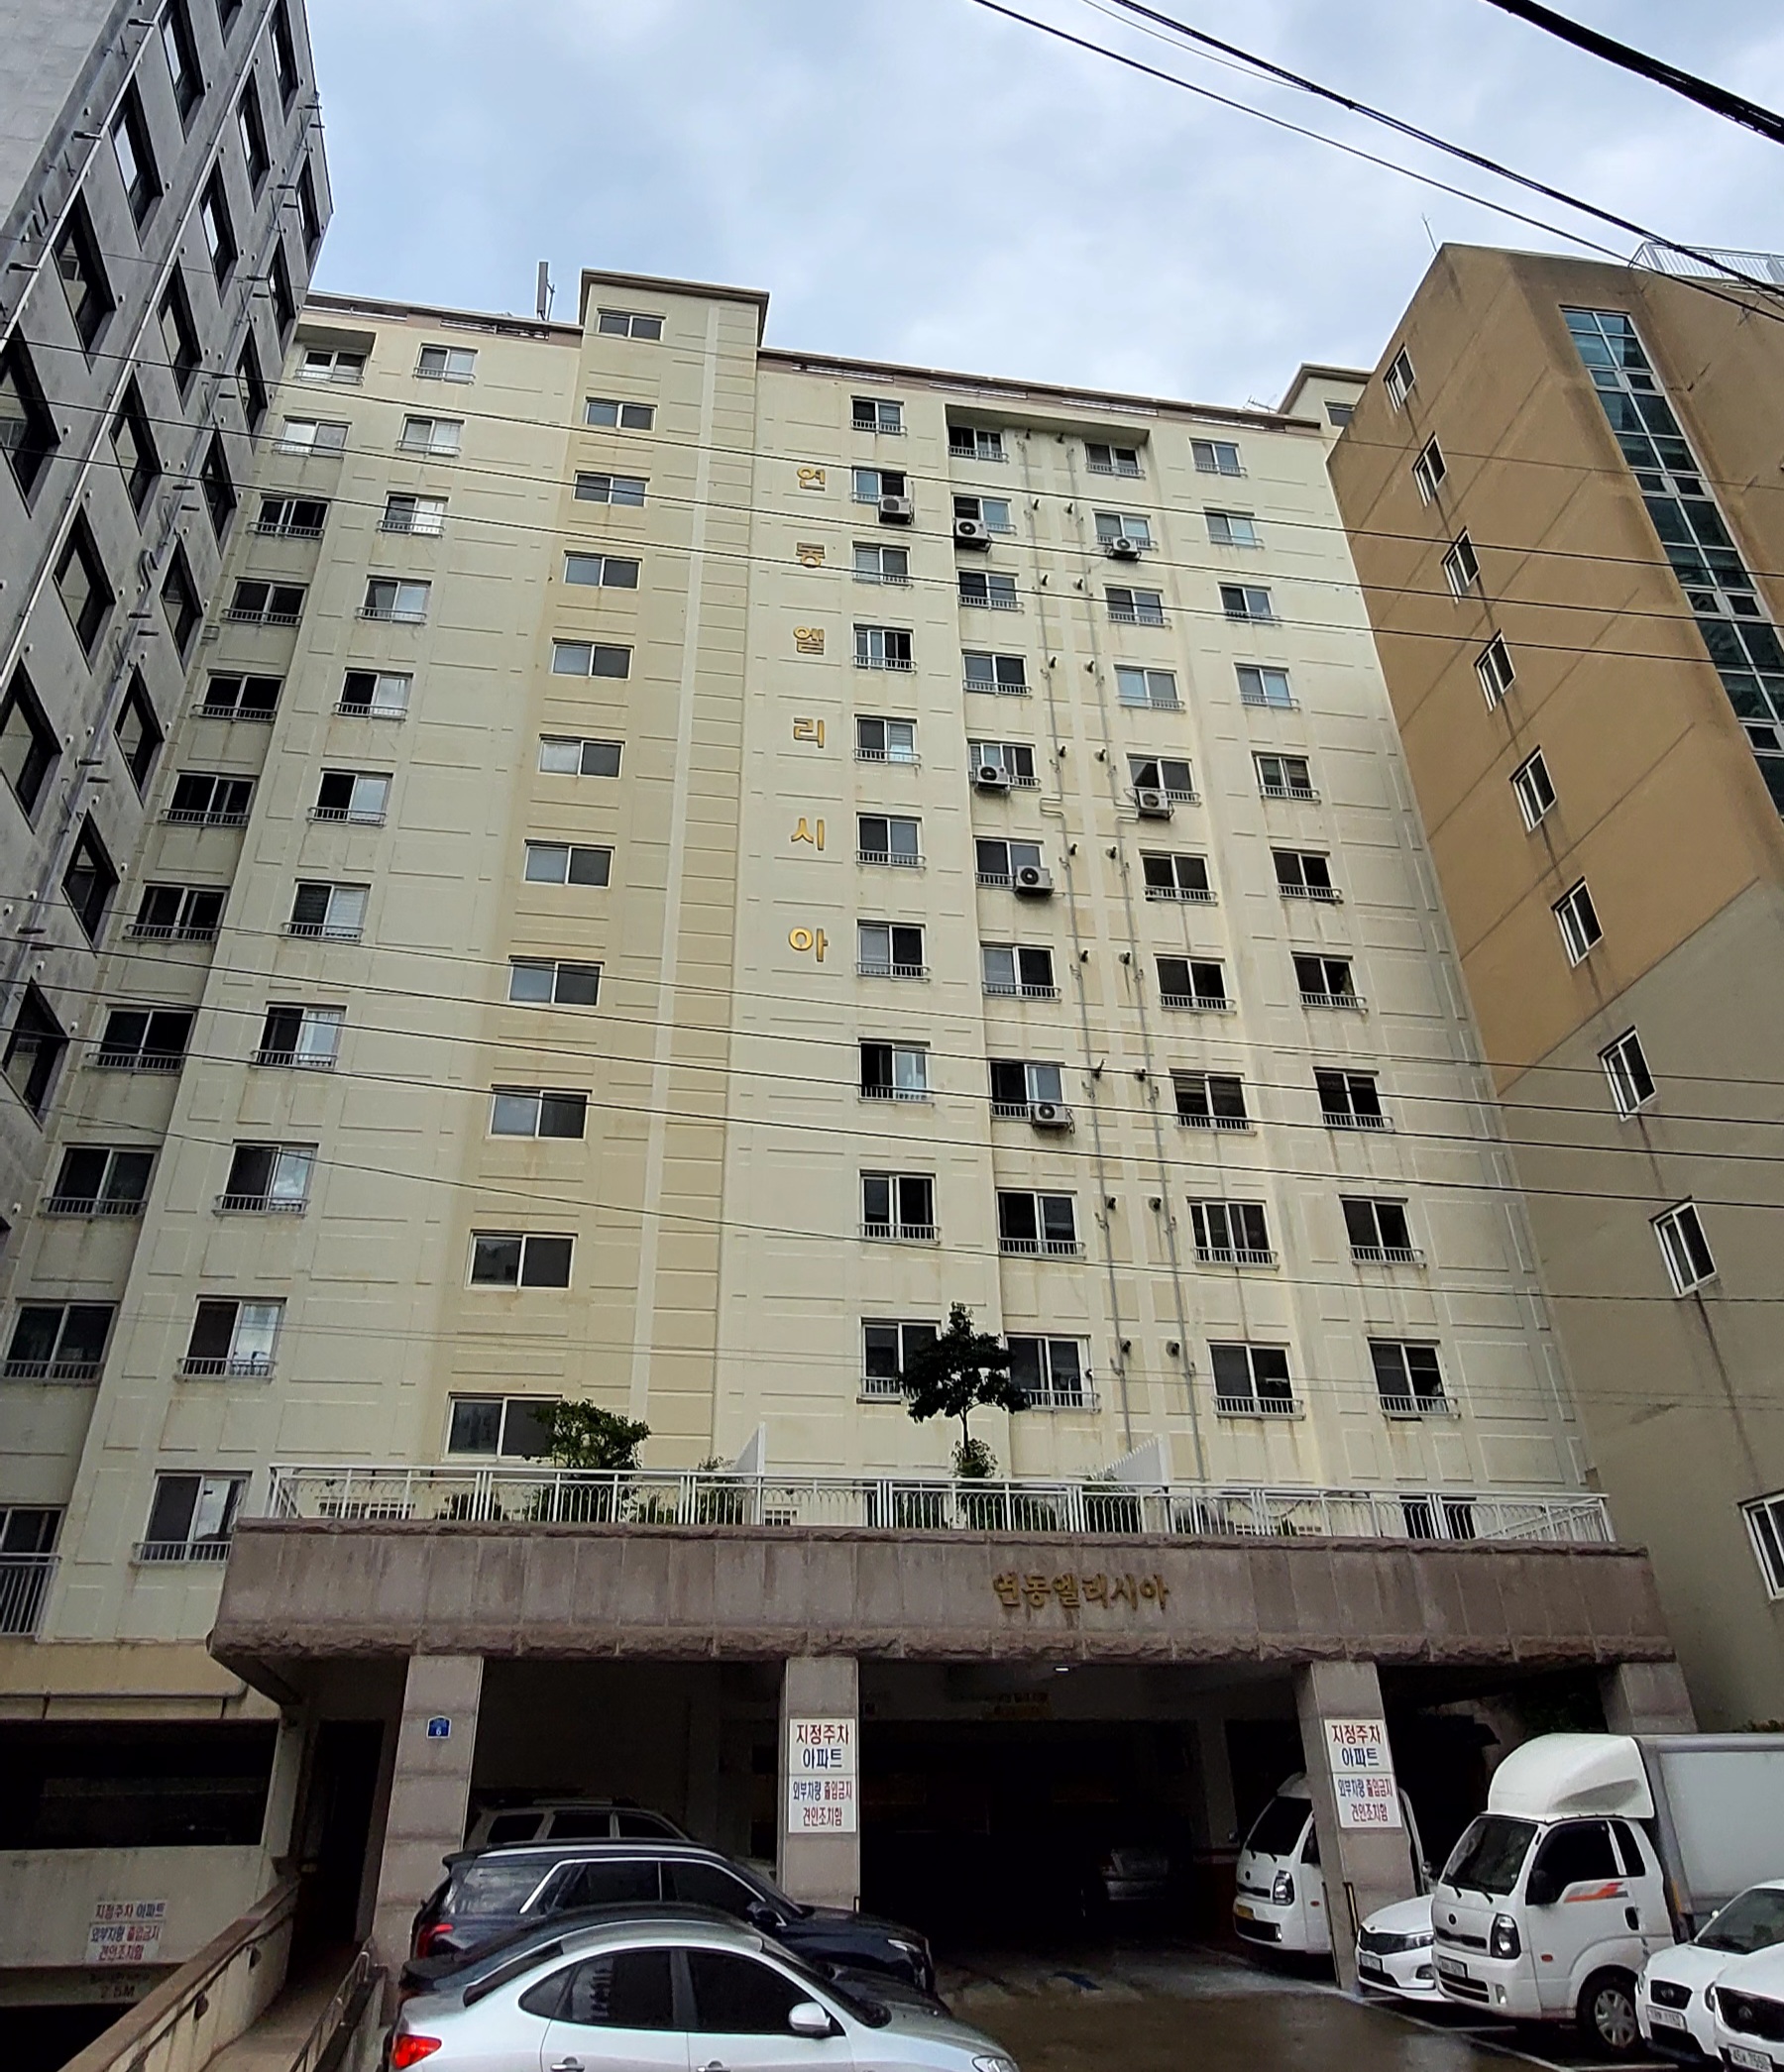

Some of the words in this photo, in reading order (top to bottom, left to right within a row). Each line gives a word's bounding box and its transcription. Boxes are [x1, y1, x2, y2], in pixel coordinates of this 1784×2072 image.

[789, 467, 829, 962] 연동엘리시아
[993, 1572, 1170, 1611] 연동엘리시아
[796, 1724, 849, 1745] 지정주차
[1331, 1724, 1381, 1744] 지정주차
[803, 1748, 842, 1769] 아파트
[1342, 1747, 1380, 1767] 아파트
[793, 1781, 822, 1801] 외부차량
[825, 1781, 852, 1799] 출입금지
[1338, 1779, 1365, 1799] 외부차량
[1366, 1779, 1393, 1797] 출입금지
[95, 1904, 134, 1919] 지정주차
[136, 1903, 166, 1918] 아파트
